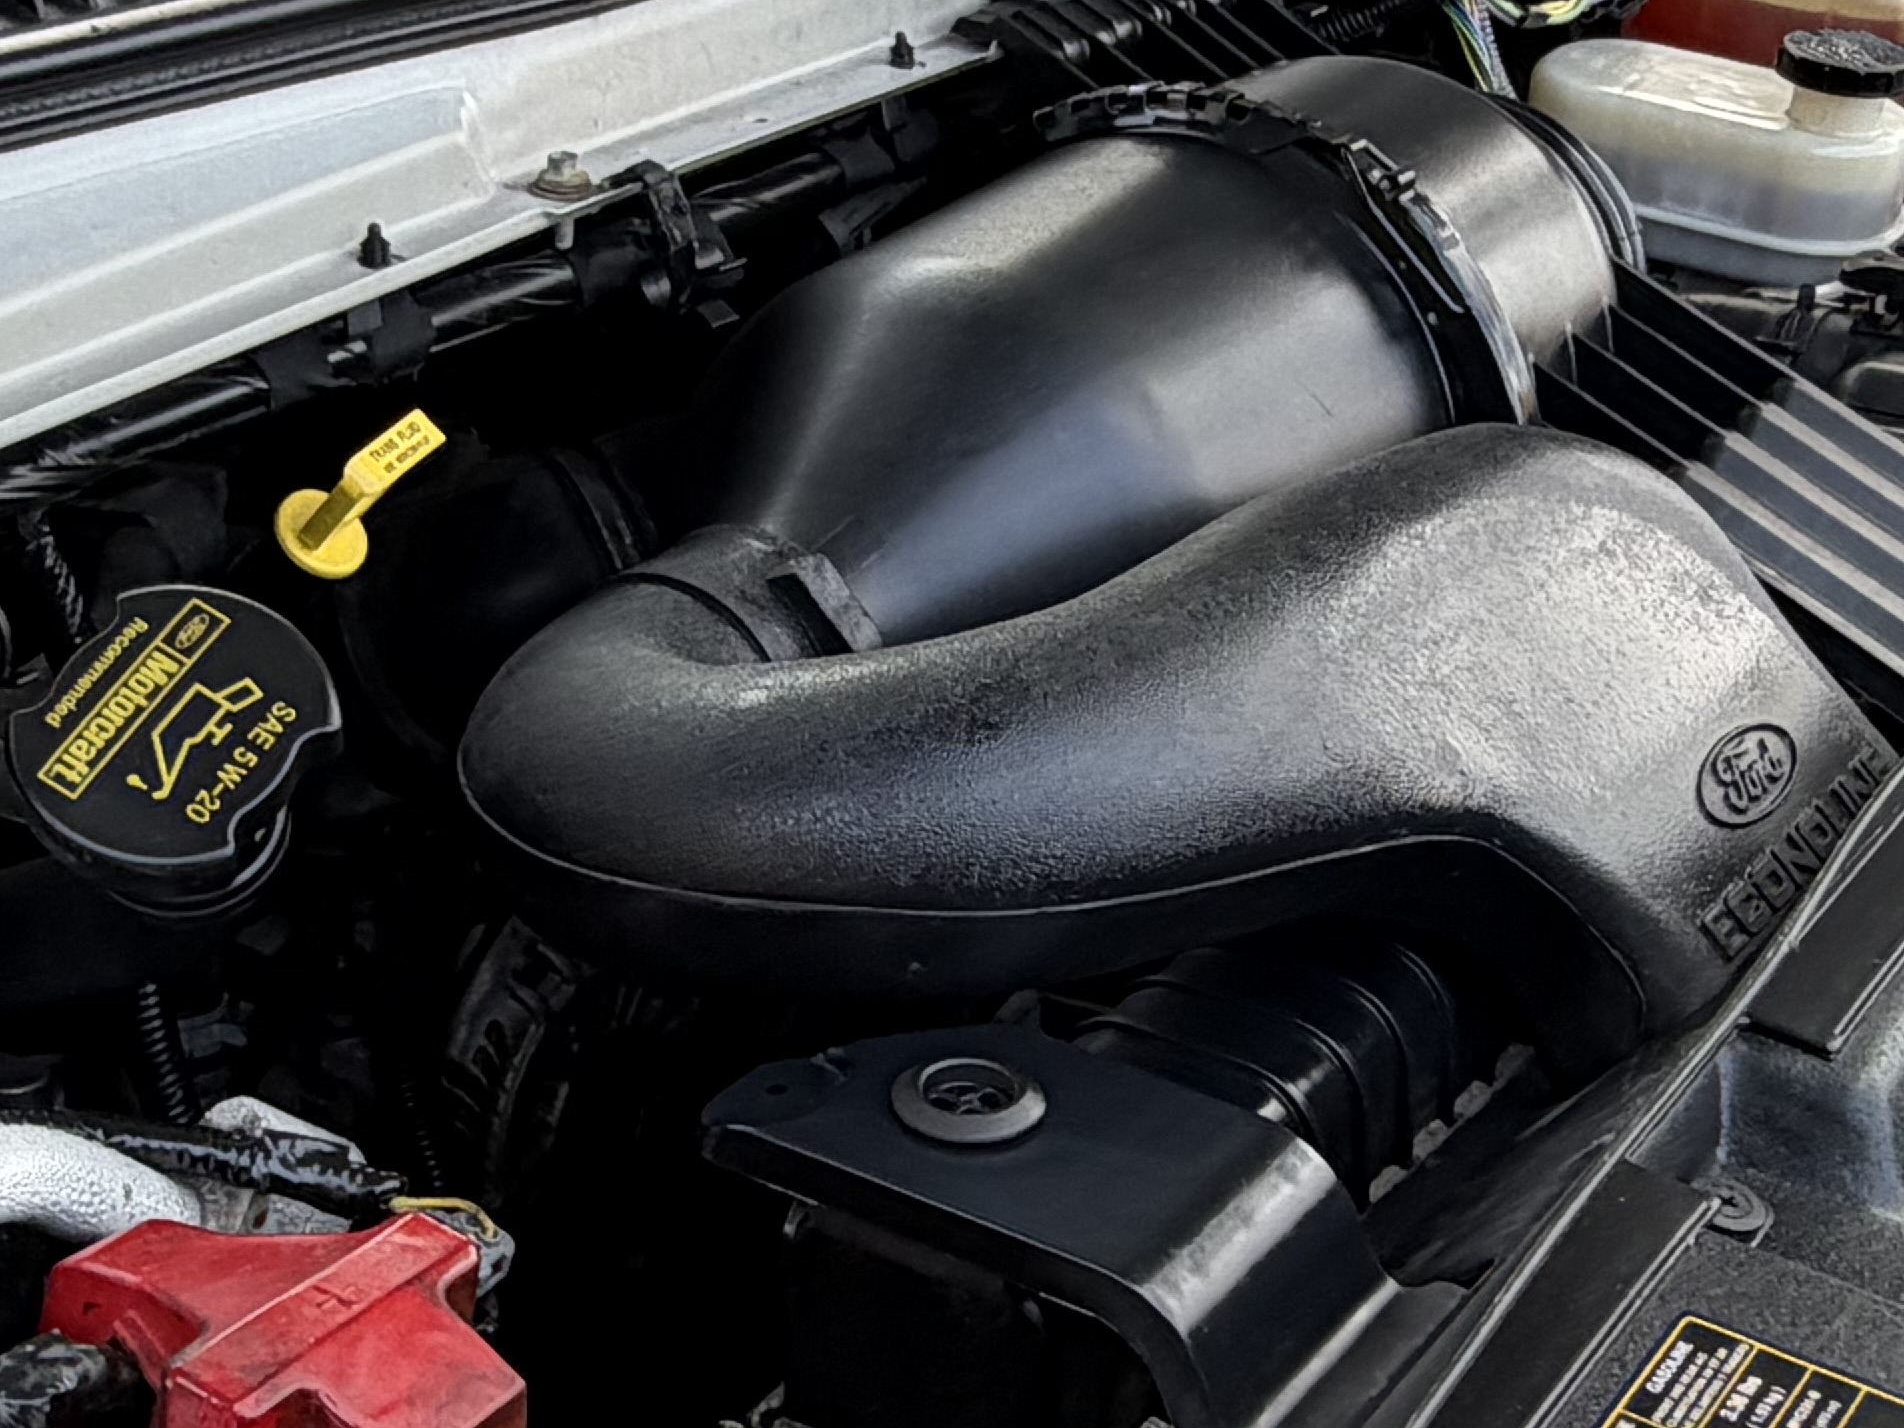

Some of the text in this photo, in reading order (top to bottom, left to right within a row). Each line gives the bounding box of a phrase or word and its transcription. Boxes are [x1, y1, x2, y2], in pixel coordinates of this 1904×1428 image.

[43, 615, 152, 730] Recommended
[46, 650, 182, 790] Motorcraft
[181, 700, 299, 826] SAE 5W-20
[1710, 735, 1786, 815] Ford
[1644, 1338, 1694, 1394] GASOLINE
[1735, 1372, 1763, 1396] lbs
